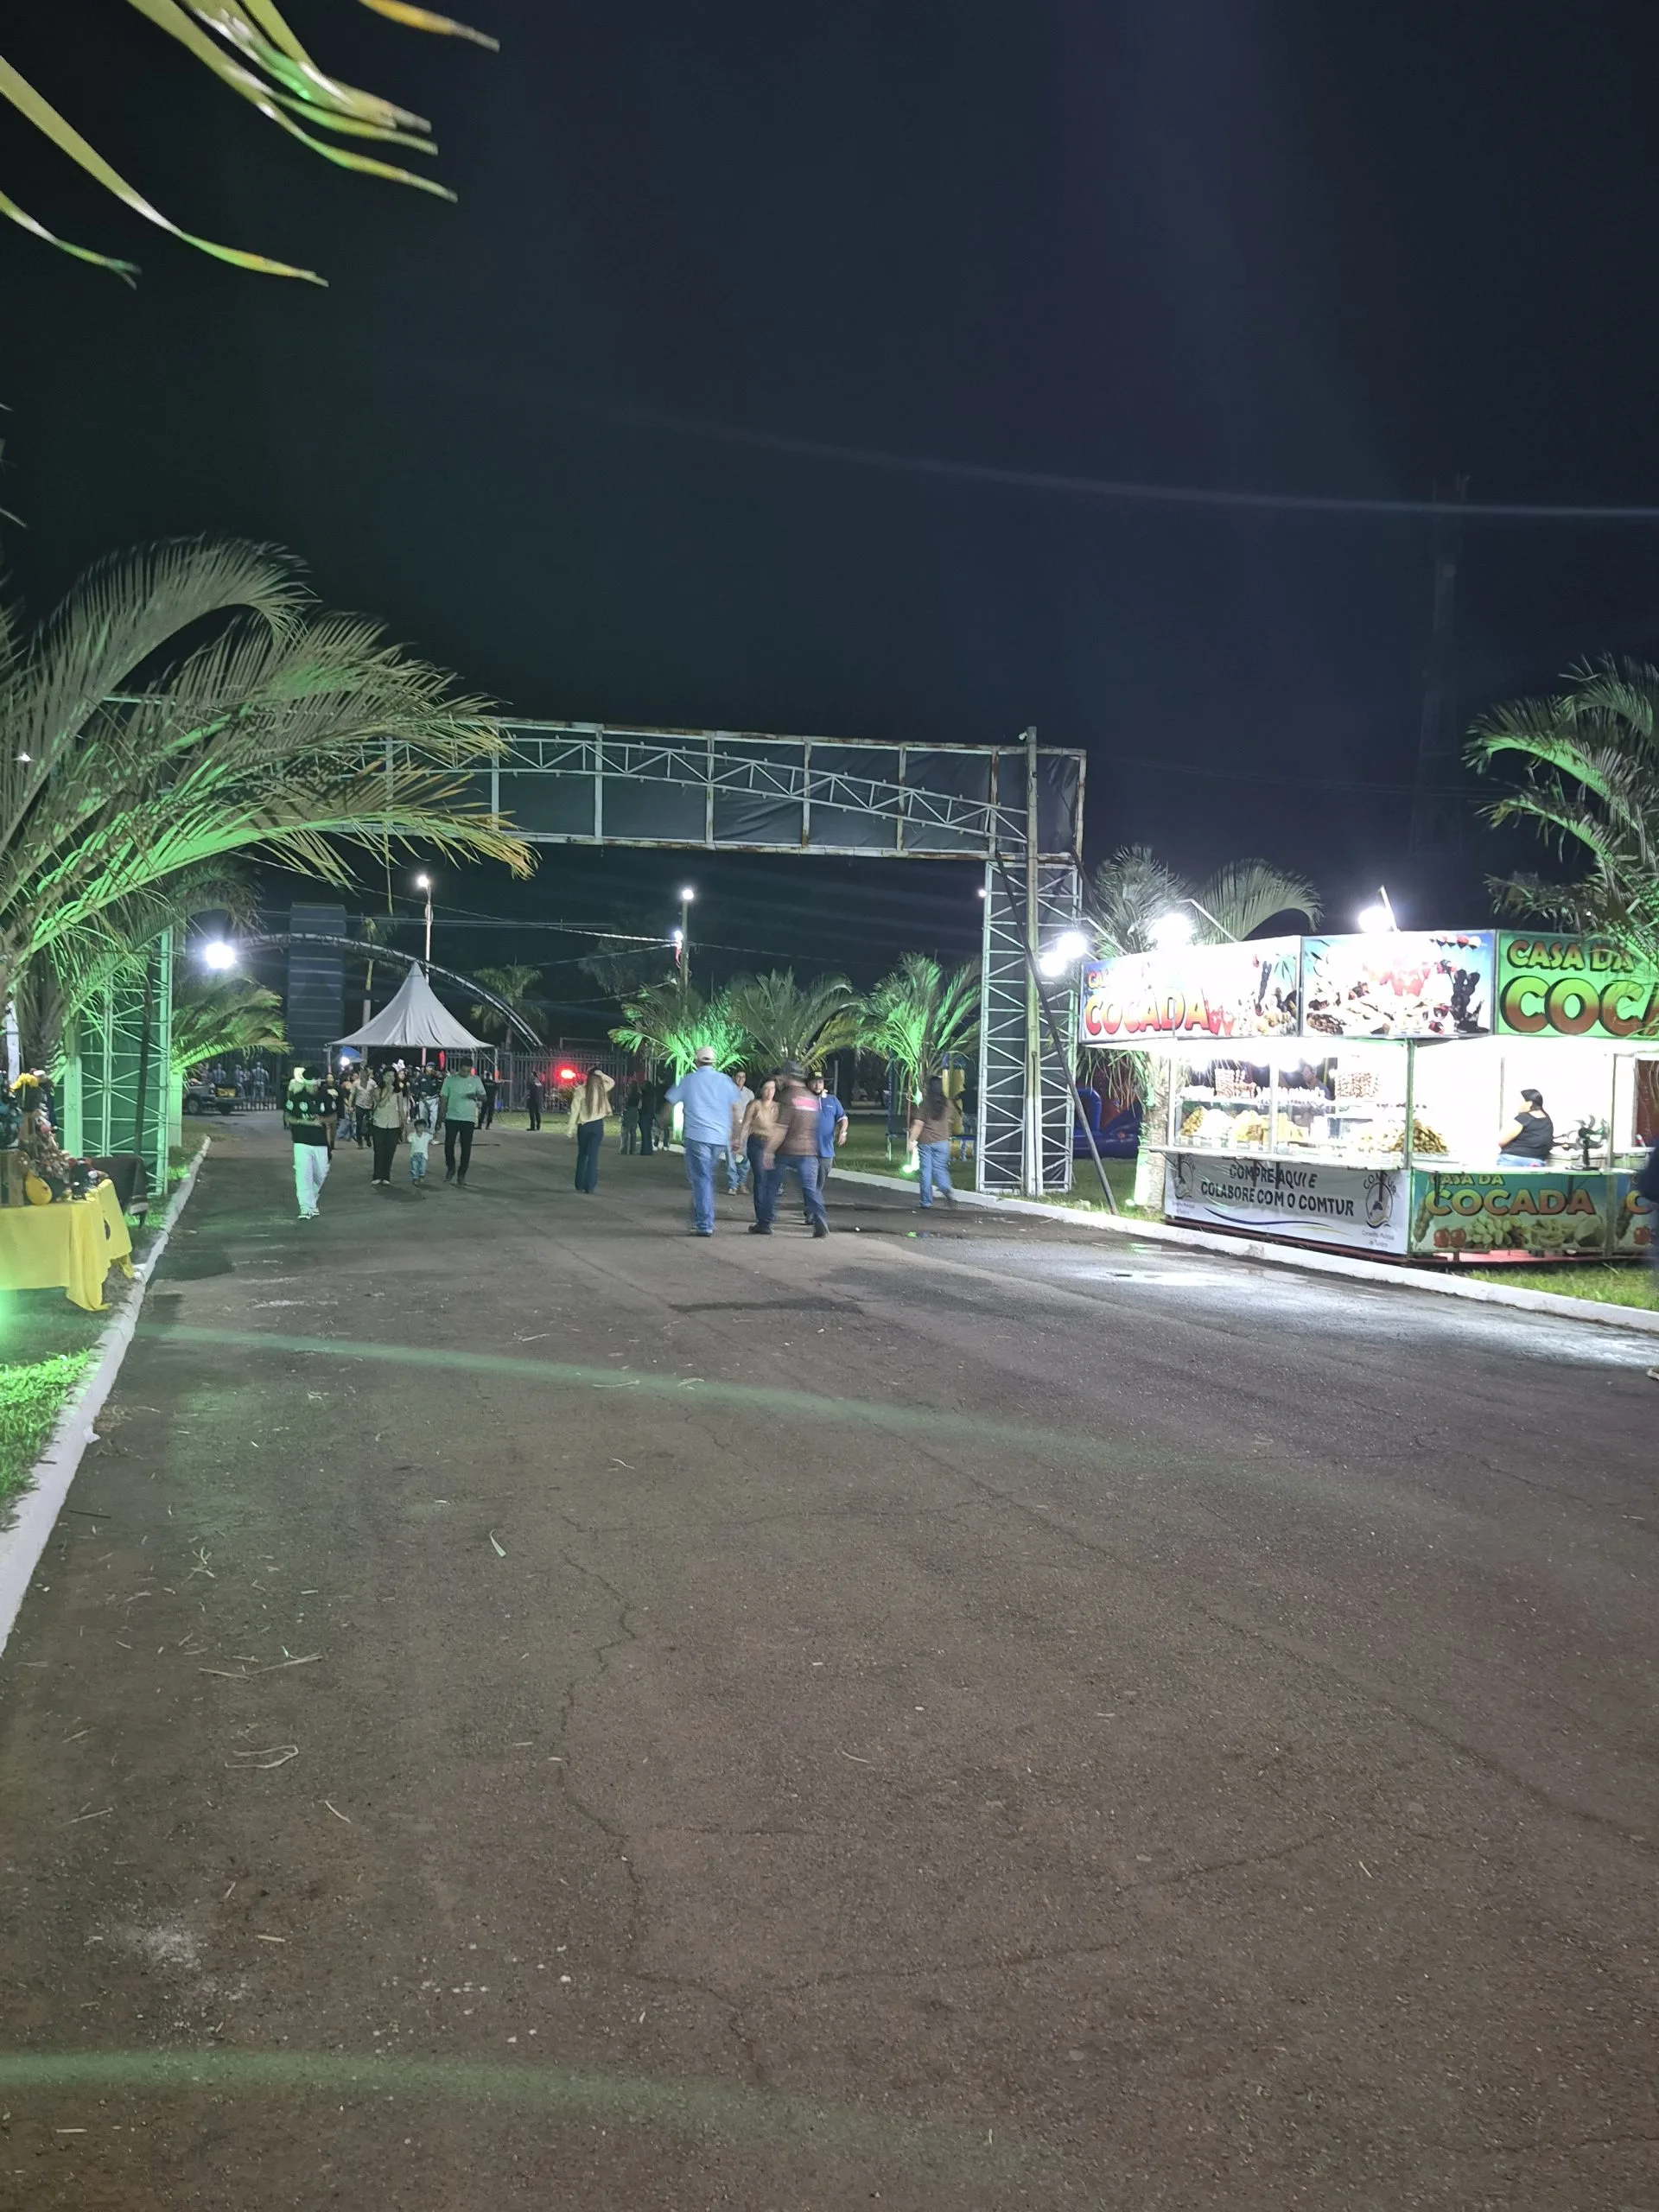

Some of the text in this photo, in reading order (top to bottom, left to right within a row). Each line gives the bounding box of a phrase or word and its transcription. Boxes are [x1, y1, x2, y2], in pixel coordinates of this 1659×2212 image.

[1507, 939, 1585, 971] CASA
[1085, 986, 1211, 1036] COCADA
[1230, 1164, 1318, 1189] COMPRE AQUI E
[1478, 1174, 1506, 1186] DA
[1201, 1181, 1354, 1217] COLABORE COM O COMTUR
[1425, 1188, 1597, 1217] COCADA
